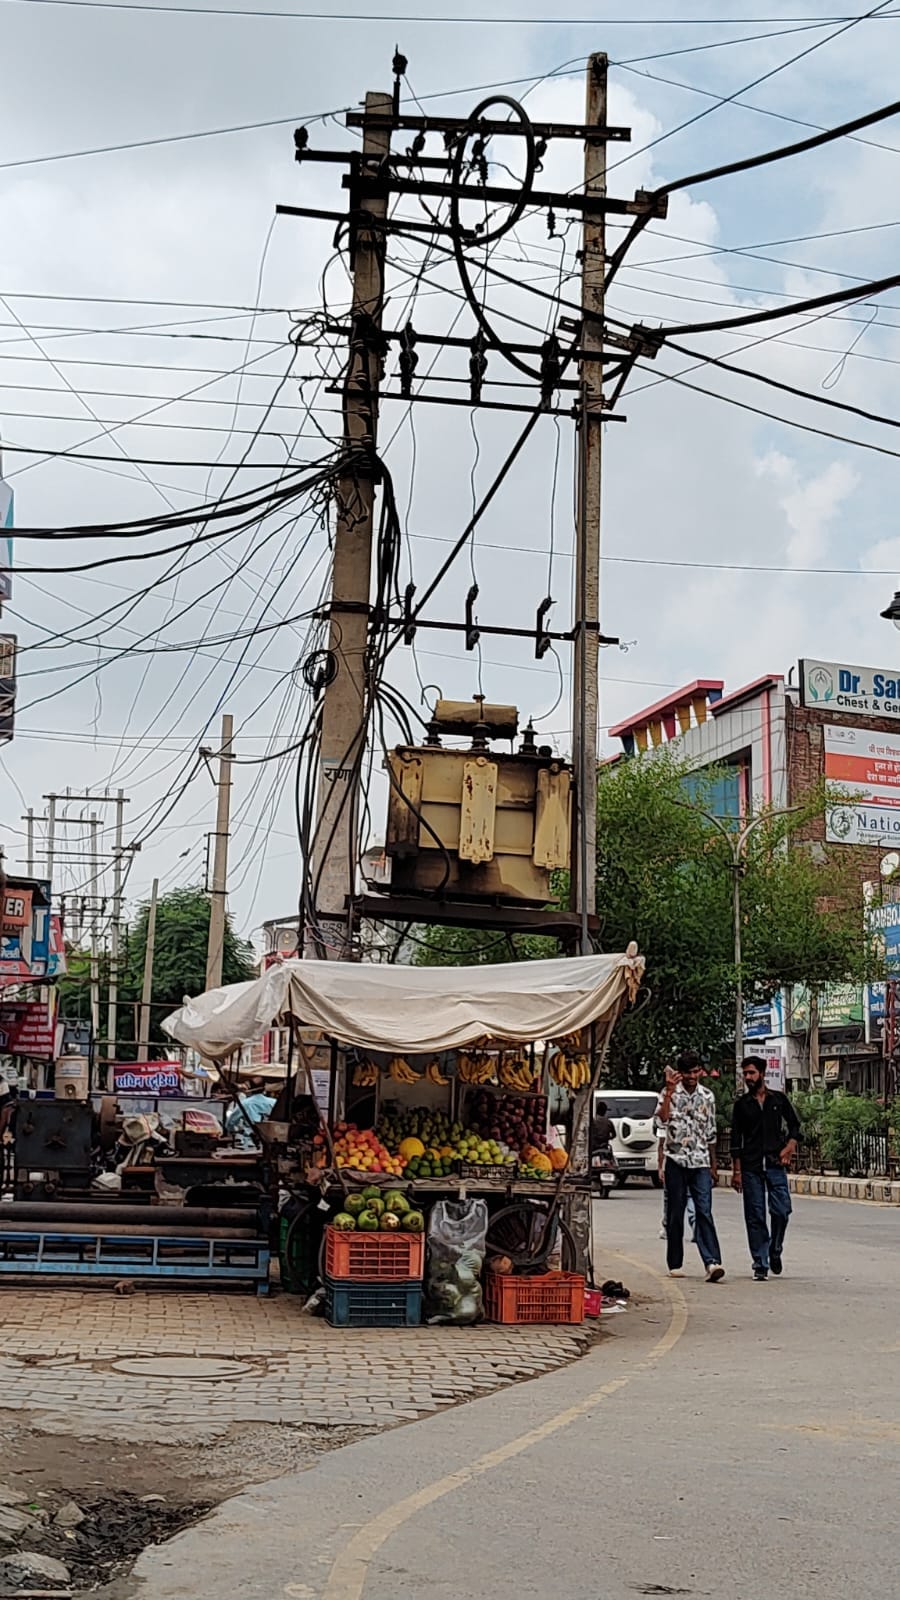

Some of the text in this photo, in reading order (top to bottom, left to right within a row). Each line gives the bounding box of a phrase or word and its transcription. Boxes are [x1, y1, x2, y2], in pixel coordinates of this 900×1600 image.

[838, 669, 866, 695] Dr.
[836, 694, 869, 709] Chest
[872, 699, 880, 710] &
[116, 1072, 145, 1088] सचिन
